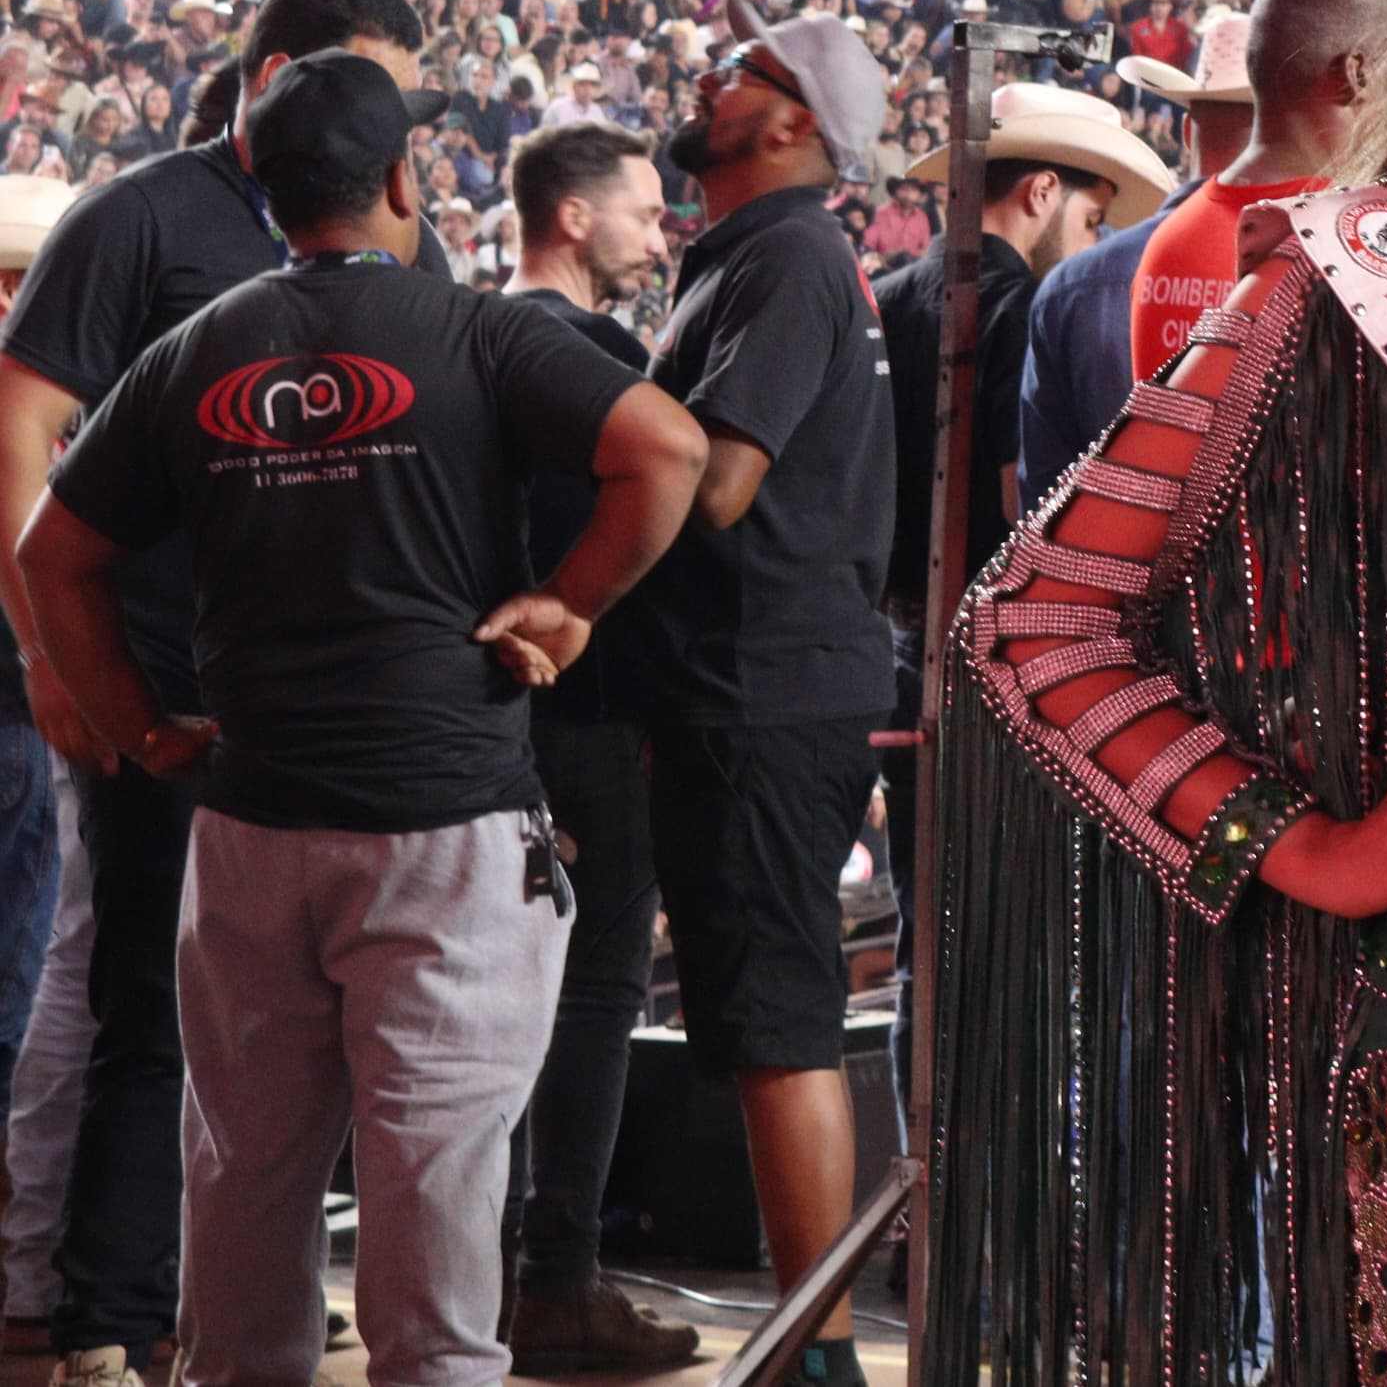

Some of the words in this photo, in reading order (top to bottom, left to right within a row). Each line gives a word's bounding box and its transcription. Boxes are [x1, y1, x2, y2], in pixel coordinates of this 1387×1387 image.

[266, 450, 322, 465] PODER
[327, 449, 346, 460] DA
[352, 443, 418, 458] IMAGEM
